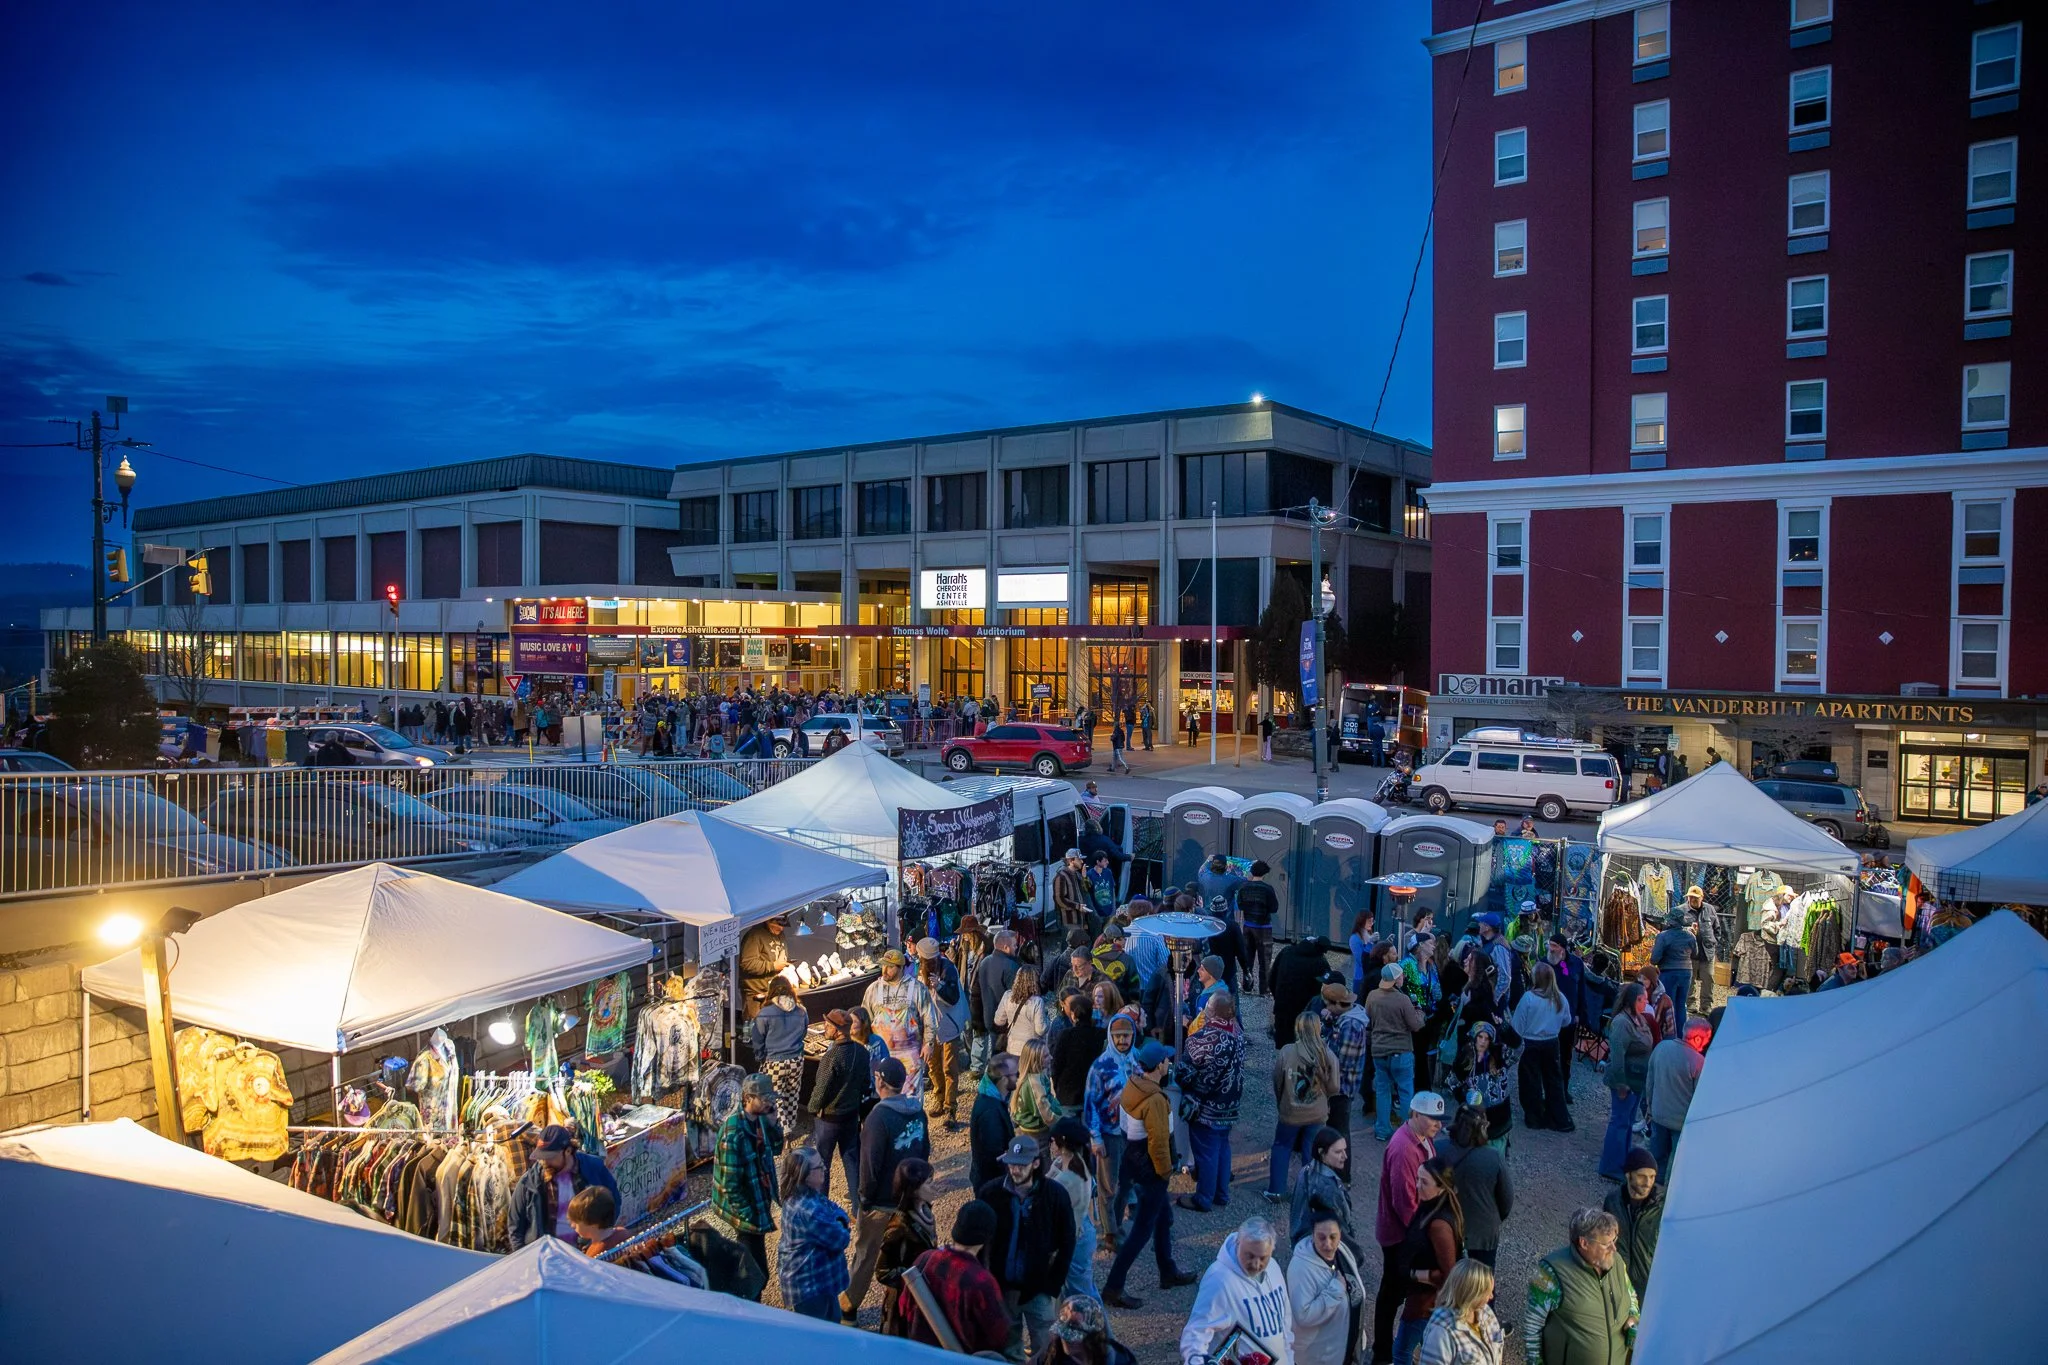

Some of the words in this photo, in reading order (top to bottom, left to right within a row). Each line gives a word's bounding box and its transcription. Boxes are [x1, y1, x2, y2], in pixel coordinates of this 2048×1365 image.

[936, 573, 967, 585] Harrah's
[936, 592, 967, 600] CENTER
[542, 606, 554, 619] IT'S
[554, 606, 566, 619] ALL
[650, 625, 736, 634] ExploreAsheville.com
[738, 625, 761, 634] Arena
[892, 627, 924, 635] Thomas
[925, 627, 949, 635] Wolfe
[976, 627, 1026, 636] Auditorium
[520, 642, 541, 652] MUSIC
[544, 643, 560, 652] LOVE
[1623, 696, 1663, 712] THE
[1671, 698, 1805, 716] VANDERBILT
[1814, 702, 1973, 723] APARTMENTS
[927, 810, 961, 836] Sacred
[945, 828, 978, 851] Batiks
[703, 927, 715, 939] WE
[719, 920, 737, 933] NEED
[703, 930, 738, 953] TICKETS
